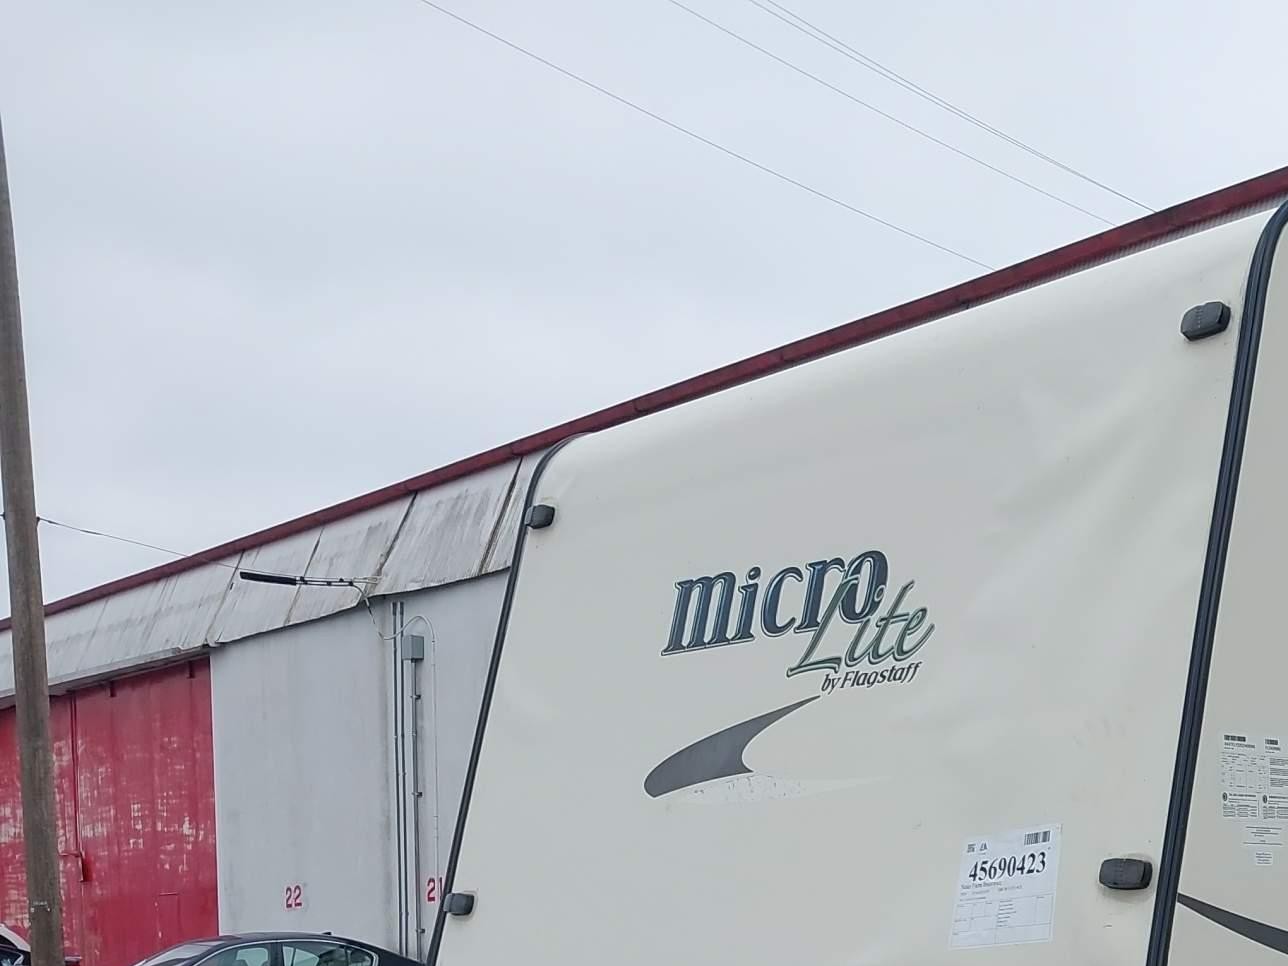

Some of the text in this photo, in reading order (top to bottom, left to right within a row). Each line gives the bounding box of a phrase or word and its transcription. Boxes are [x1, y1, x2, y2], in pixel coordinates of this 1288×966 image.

[660, 550, 889, 656] micro
[786, 580, 936, 678] Lite
[821, 661, 923, 695] by Flagstaff
[968, 851, 1046, 882] 45690423
[285, 885, 302, 908] 22
